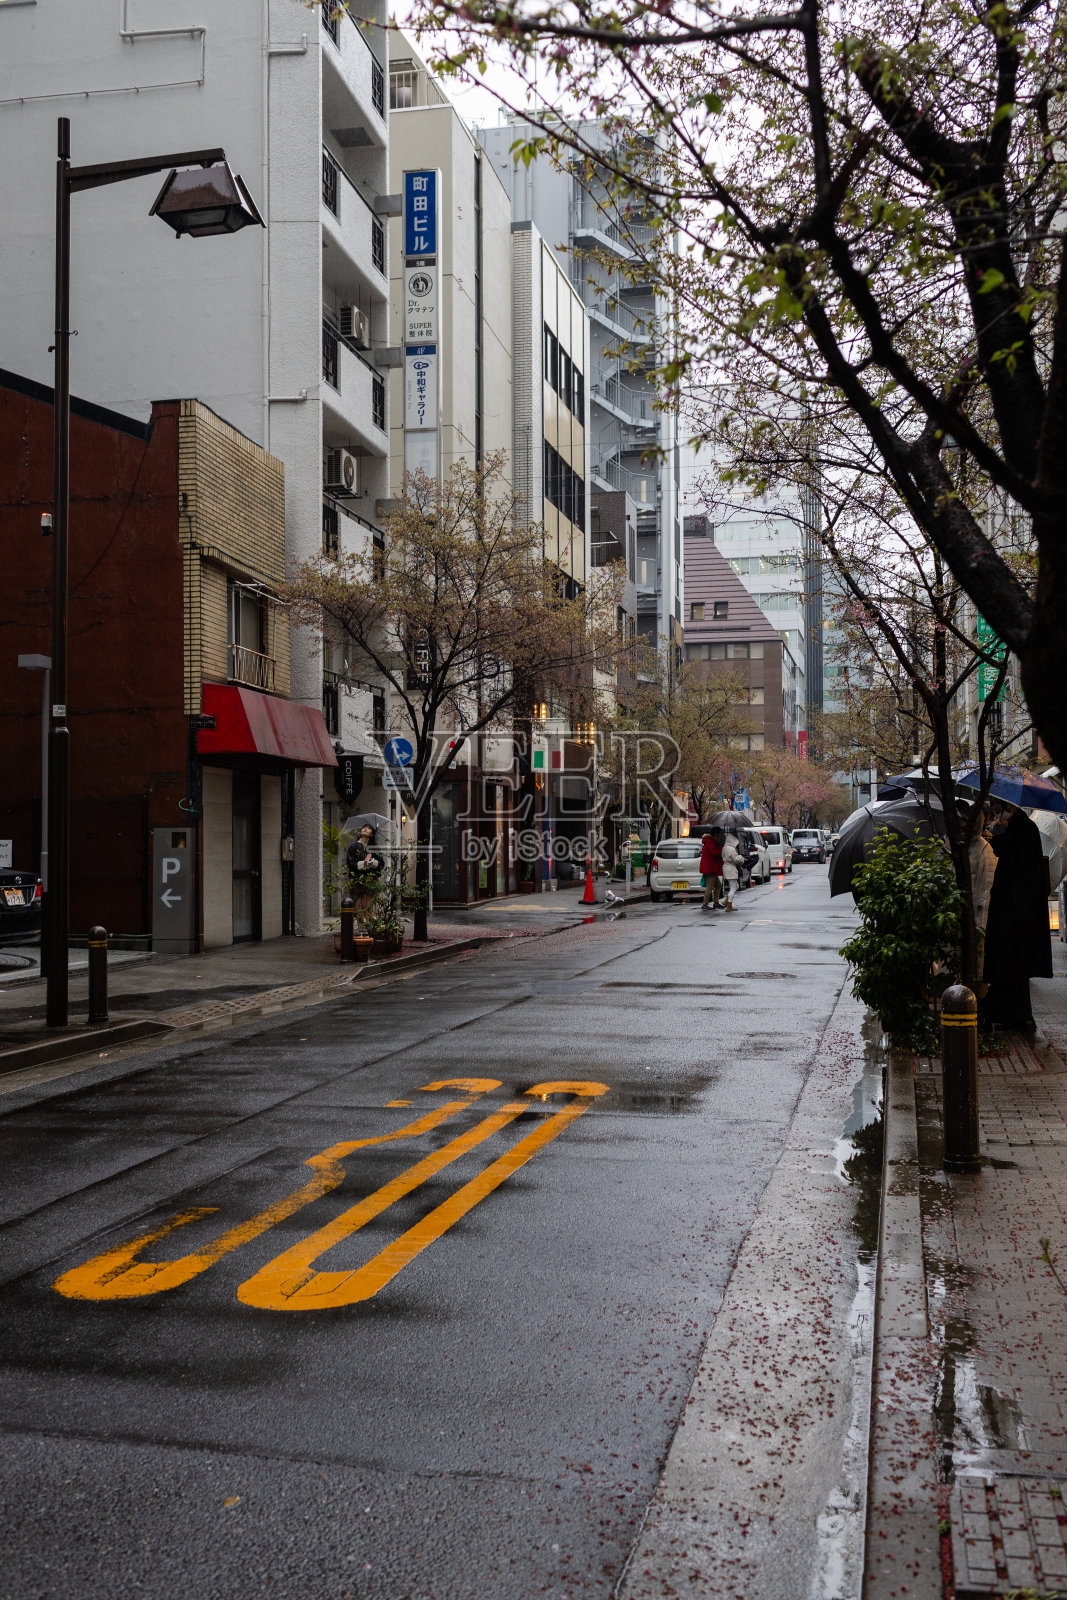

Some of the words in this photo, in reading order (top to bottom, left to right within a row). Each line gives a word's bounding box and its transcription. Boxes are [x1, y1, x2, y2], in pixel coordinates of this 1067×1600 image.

[413, 175, 429, 251] 町田ビル
[409, 322, 432, 330] SUPER
[409, 330, 433, 338] 整体院
[416, 370, 426, 425] 中和ギャラリー
[162, 857, 181, 884] P
[51, 1077, 610, 1312] 30
